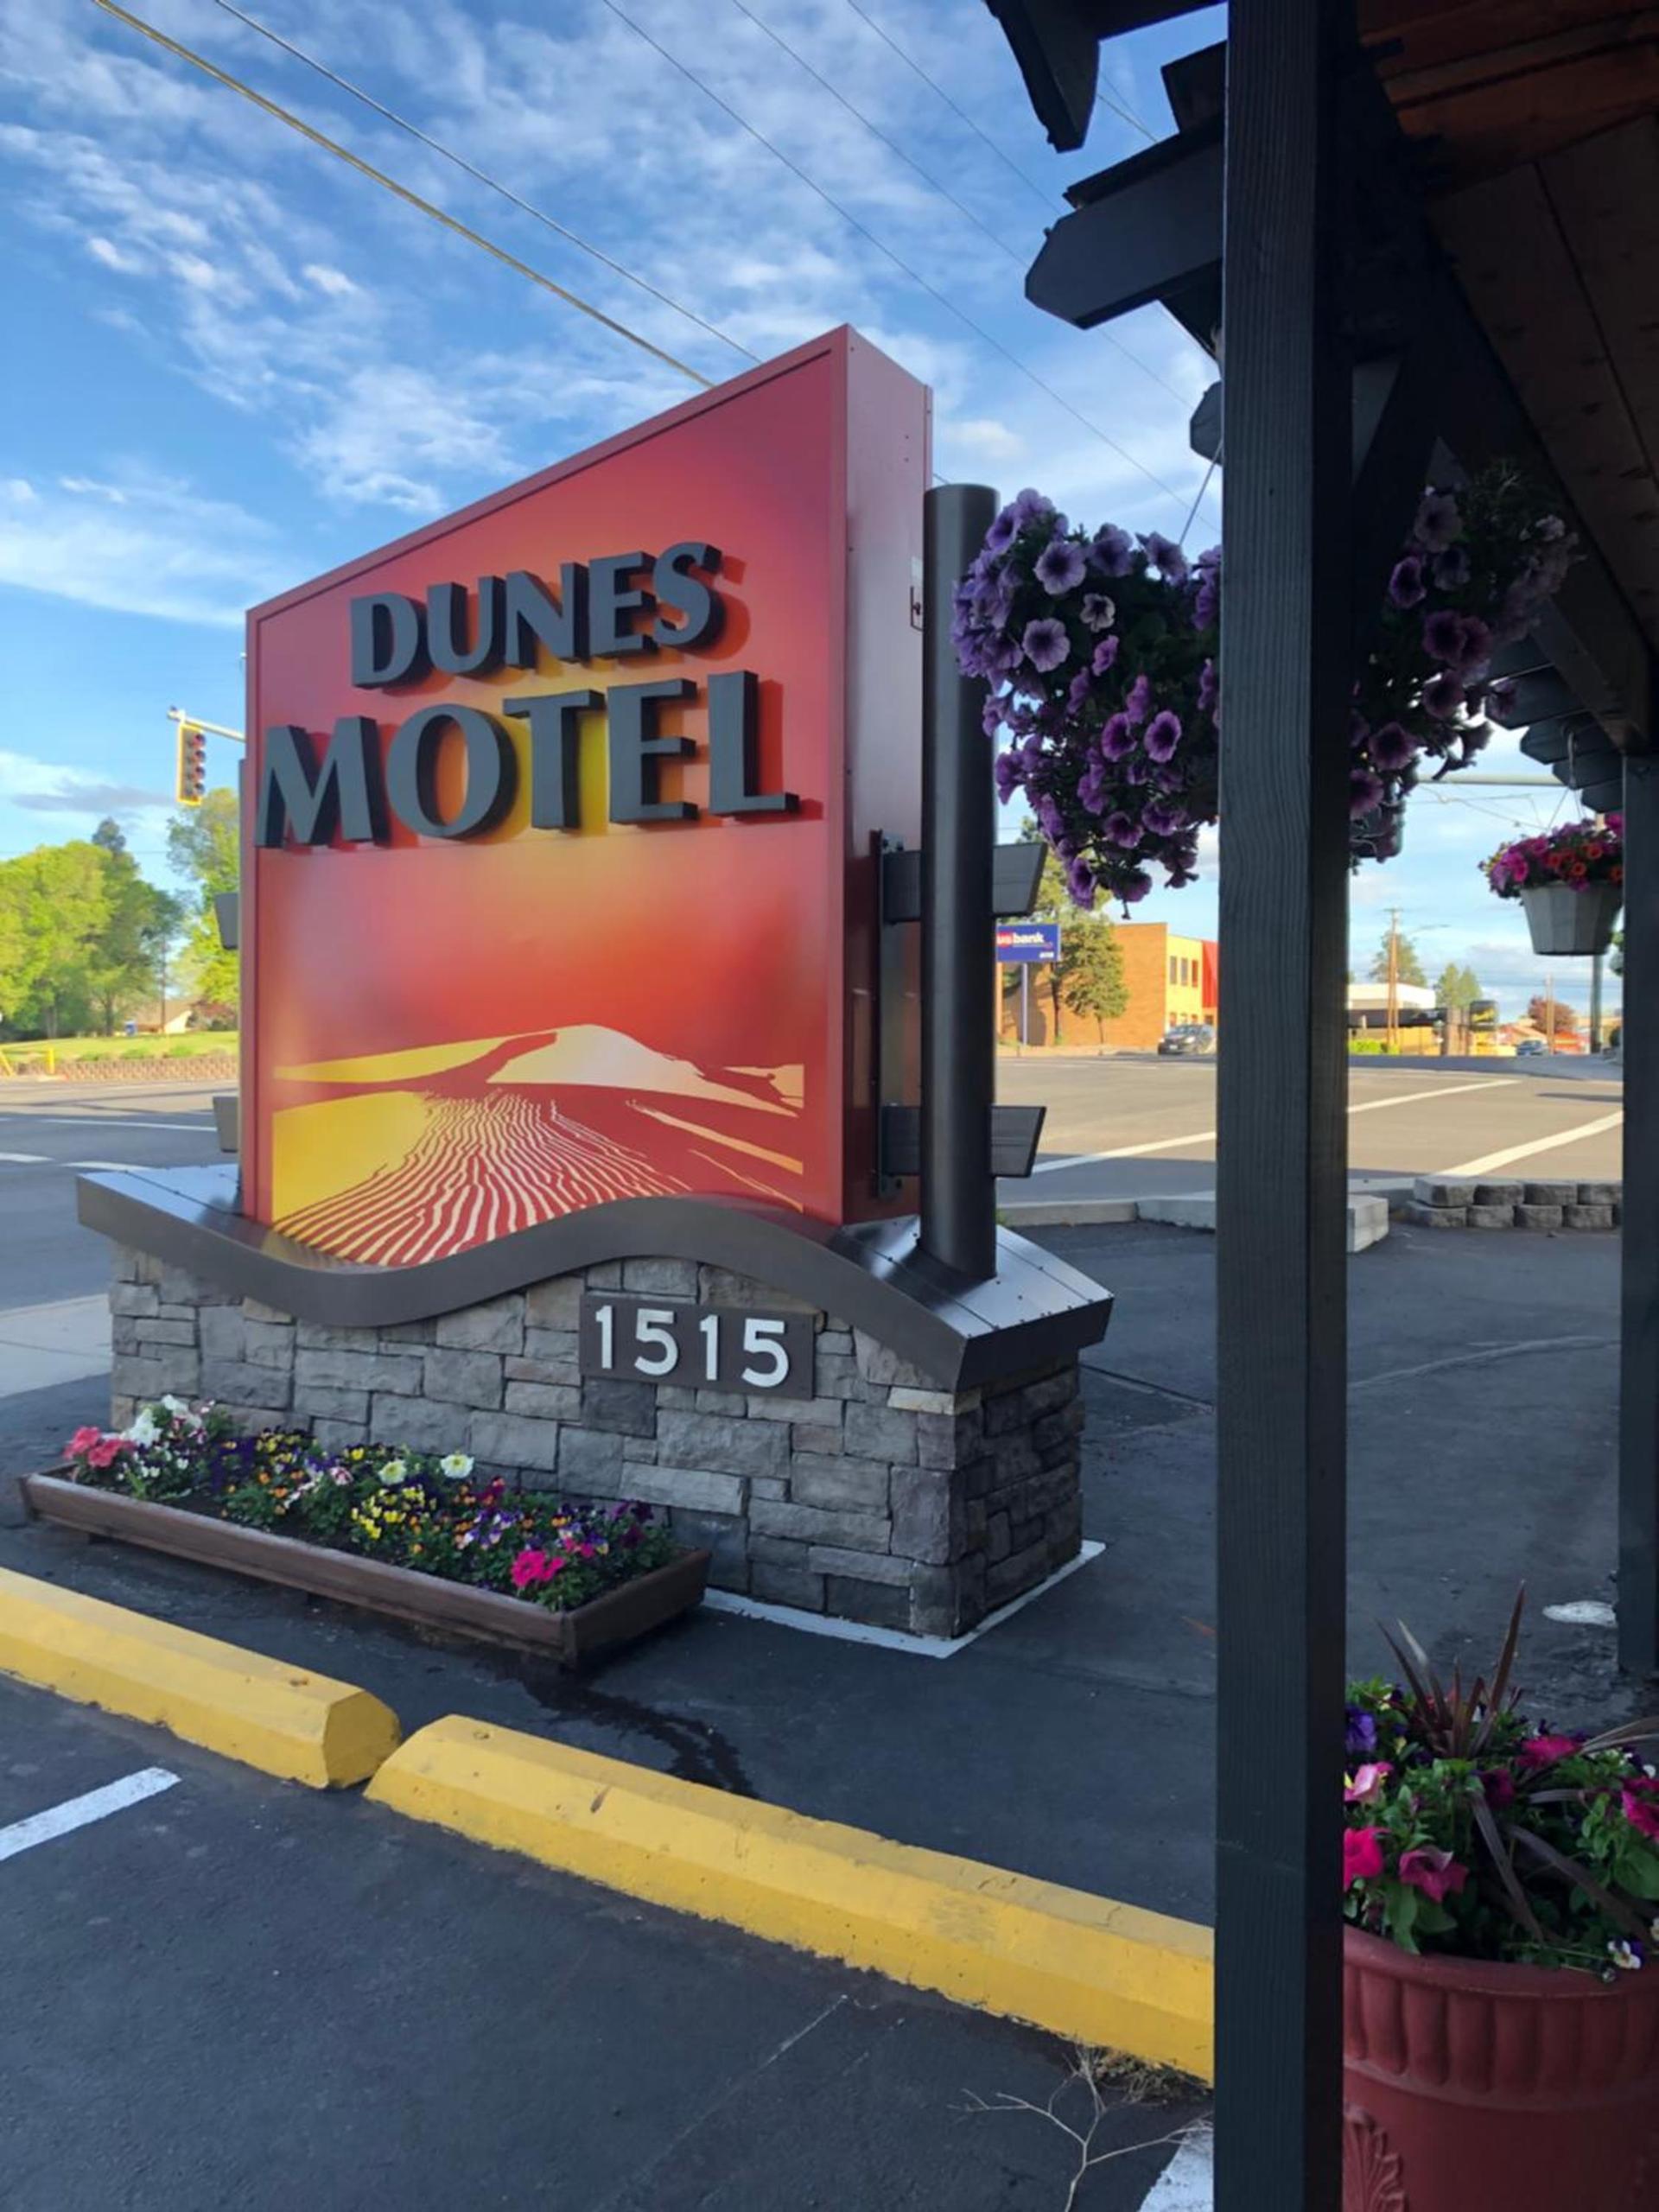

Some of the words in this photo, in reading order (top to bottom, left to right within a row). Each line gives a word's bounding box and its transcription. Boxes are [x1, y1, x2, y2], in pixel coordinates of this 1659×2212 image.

[350, 542, 722, 688] DUNES
[256, 670, 799, 849] MOTEL
[595, 1305, 790, 1388] 1515
